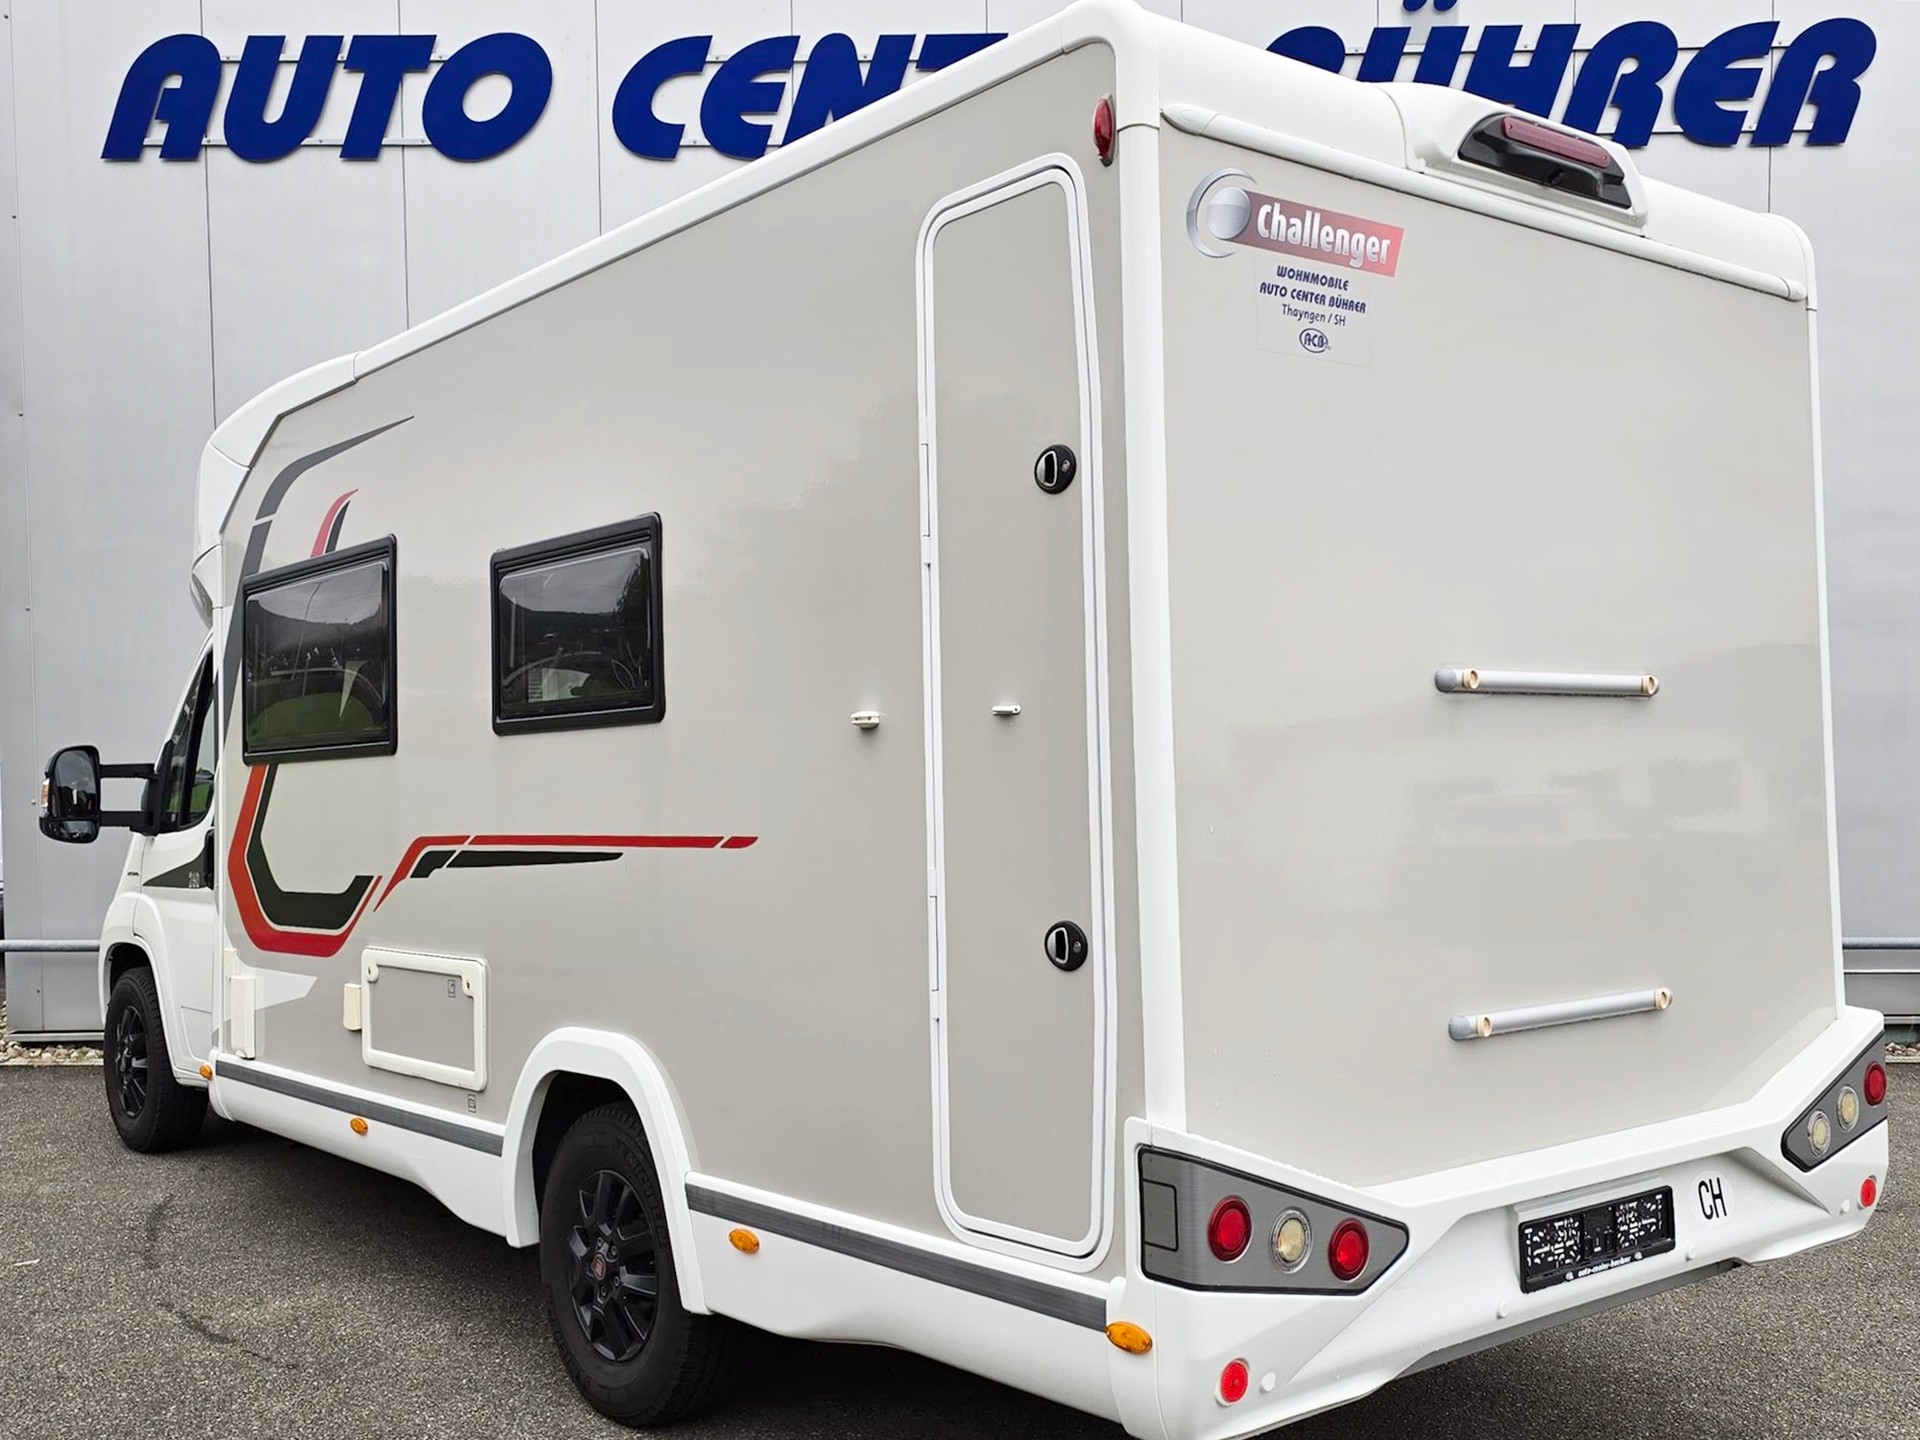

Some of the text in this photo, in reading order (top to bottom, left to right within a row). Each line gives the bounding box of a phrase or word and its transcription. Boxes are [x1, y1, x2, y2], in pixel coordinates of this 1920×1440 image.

[101, 33, 553, 163] AUTO
[1266, 0, 1877, 147] ÜHRER
[1257, 202, 1391, 268] Challenger
[1276, 265, 1349, 291] WOHNMOBILE
[1259, 282, 1367, 314] AUTO CENTER BÜHRER
[1282, 304, 1326, 325] Thayngen
[1334, 314, 1346, 326] SH
[1304, 332, 1325, 348] ACB
[1698, 1177, 1727, 1220] CH
